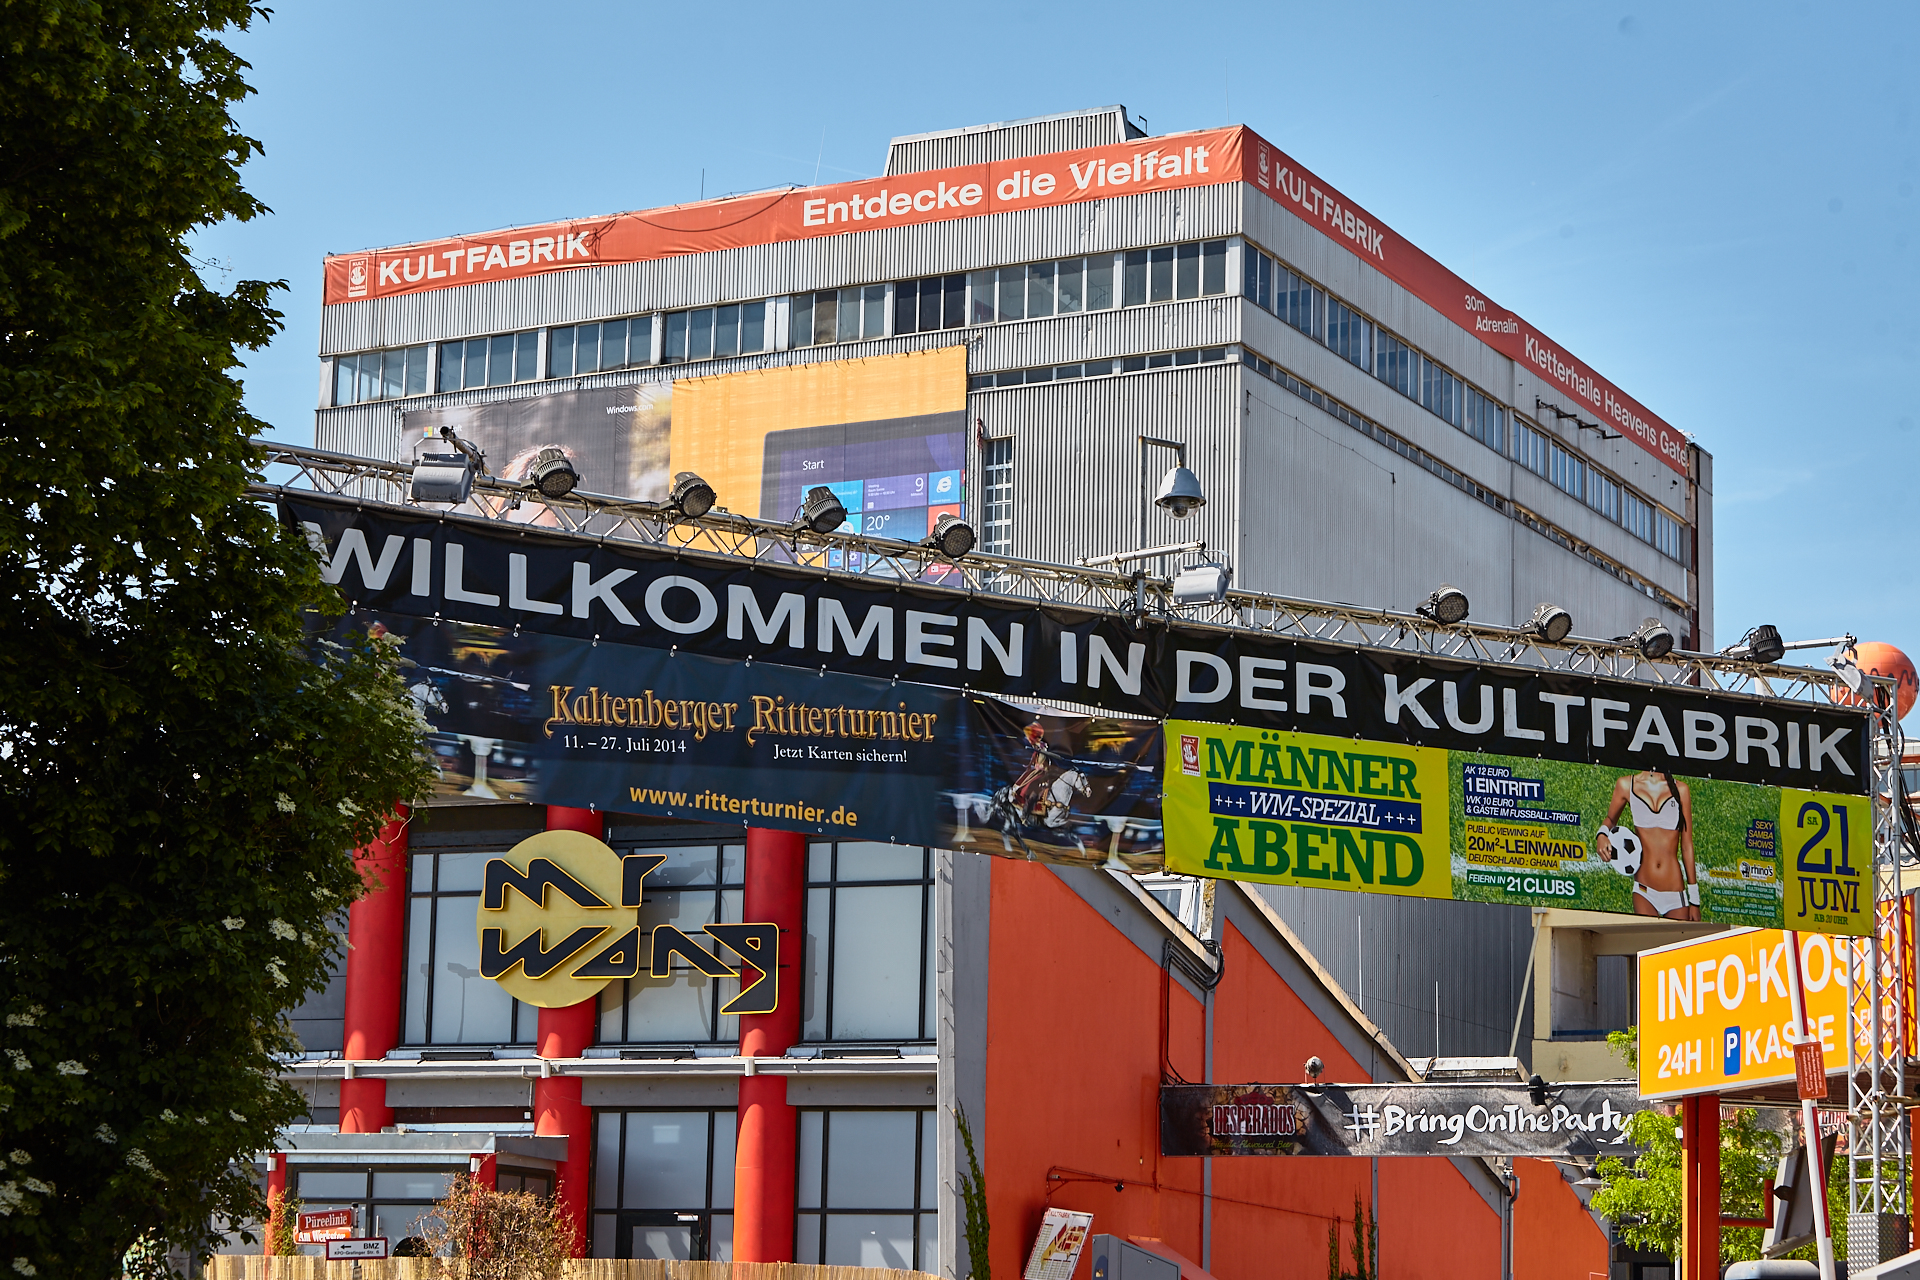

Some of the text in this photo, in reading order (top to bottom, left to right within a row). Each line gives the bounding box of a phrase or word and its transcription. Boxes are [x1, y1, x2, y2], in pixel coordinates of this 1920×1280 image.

[802, 145, 1209, 228] Entdecke die Vielfalt
[1275, 161, 1385, 261] KULTFABRIK
[379, 230, 592, 287] KULTFABRIK
[1464, 294, 1486, 312] 30m
[1475, 315, 1519, 334] Adrenalin
[606, 403, 654, 415] Windows.com
[1525, 333, 1687, 468] Kletterhalle Heavens Gate
[802, 459, 825, 471] Start
[915, 477, 924, 492] 9
[302, 520, 1856, 776] WILLKOMMEN IN DER KULTFABRIK
[543, 685, 939, 748] Kaltenberger Ritterturnier
[563, 735, 584, 749] 11.
[600, 736, 622, 751] 27.
[626, 737, 650, 753] Juli
[653, 739, 687, 753] 2014
[773, 744, 908, 763] Jetzt Karten sichern!
[1205, 731, 1422, 800] MÄNNER
[1464, 765, 1510, 778] AK 12 EURO
[1465, 777, 1541, 798] 1 EINTRITT
[629, 786, 858, 827] www.ritterturnier.de
[1249, 791, 1381, 826] WM-SPEZIAL
[1483, 797, 1492, 806] 10
[1492, 798, 1515, 808] EURO
[1473, 803, 1499, 816] GÄSTE
[1500, 807, 1509, 817] IM
[1510, 808, 1579, 823] FUSSBALL-TRIKOT
[1807, 816, 1818, 826] SA
[1467, 824, 1546, 839] PUBLIC VIEWING AUF
[1748, 829, 1774, 840] SAMBA
[1755, 820, 1774, 830] SEXY
[1748, 838, 1774, 850] SHOWS
[1796, 801, 1860, 877] 21.
[1203, 816, 1425, 887] ABEND
[1468, 853, 1525, 866] DEUTSCHLAND
[1530, 858, 1558, 868] GHANA
[1751, 863, 1774, 877] rhino's
[1468, 873, 1576, 896] FEIERN IN 21 CLUBS
[1797, 876, 1861, 918] JUNI
[1813, 913, 1849, 925] AB 20 UHR
[1657, 924, 1894, 1022] INFO-KOSK
[1657, 1038, 1702, 1079] 24H
[1213, 1104, 1296, 1135] DESPERADOS
[1343, 1098, 1634, 1146] #BringOnTheParty
[1239, 1139, 1275, 1149] Flavoured
[1277, 1140, 1293, 1148] Beer
[304, 1212, 348, 1229] Püreelinie
[298, 1231, 311, 1242] Am
[363, 1242, 380, 1250] BMZ
